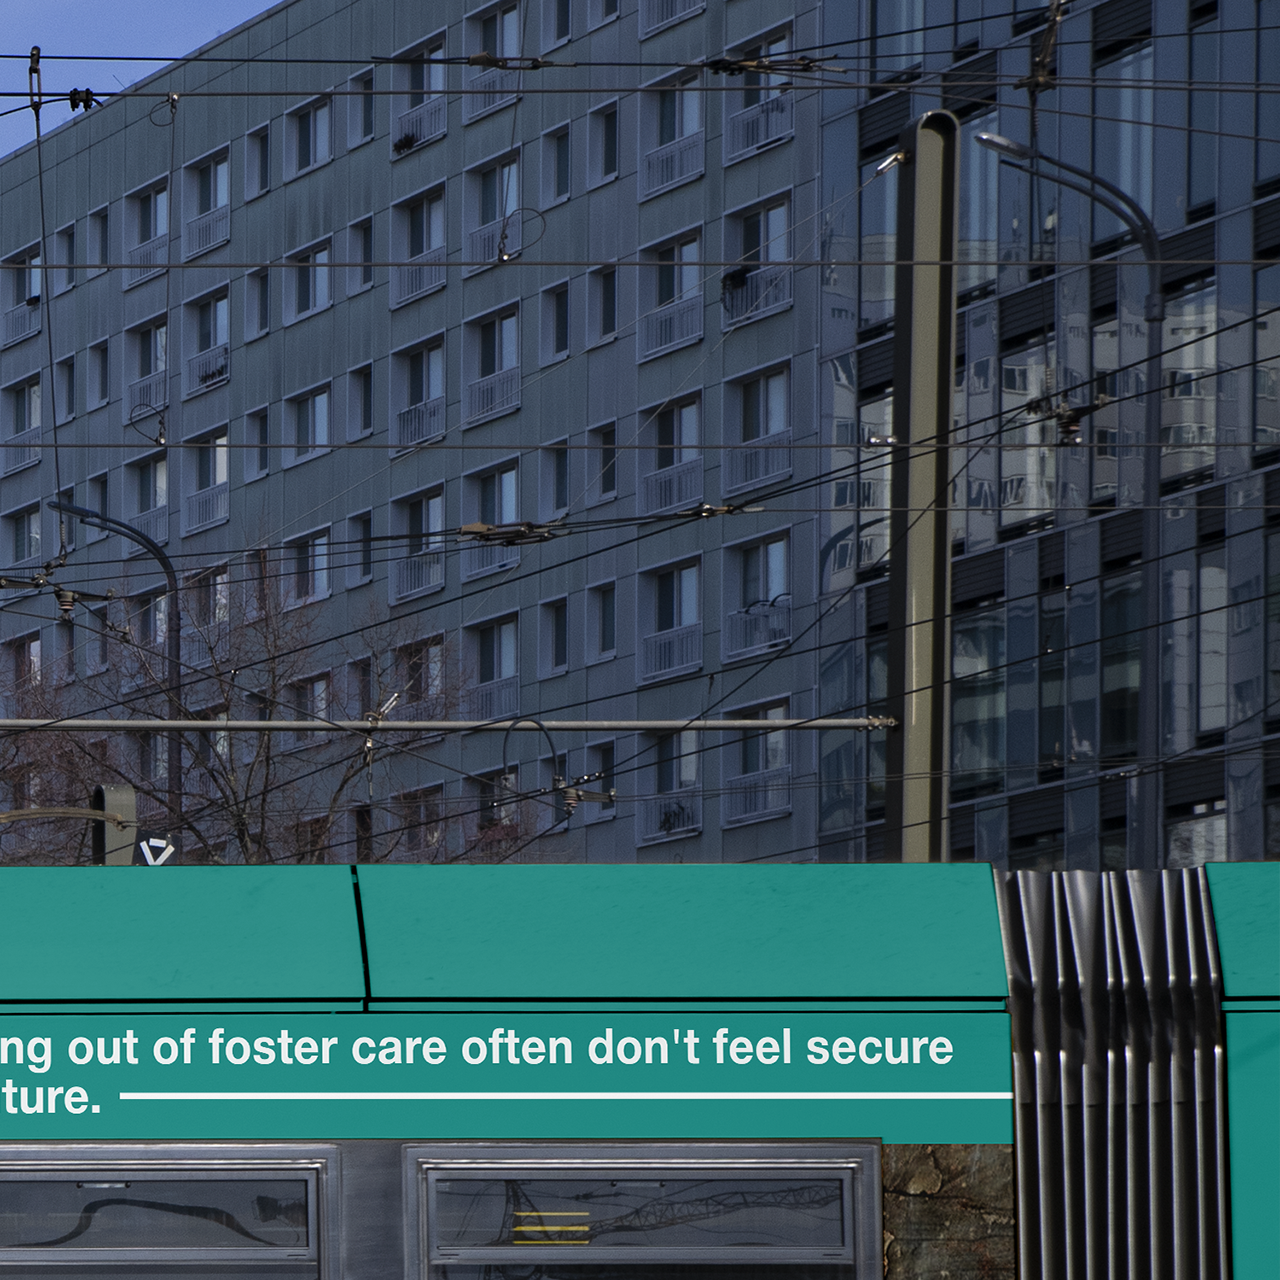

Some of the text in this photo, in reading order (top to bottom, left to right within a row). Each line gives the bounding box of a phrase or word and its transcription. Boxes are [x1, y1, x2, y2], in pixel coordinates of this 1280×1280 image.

[69, 1029, 138, 1065] out
[154, 1027, 195, 1065] of
[209, 1027, 338, 1065] foster
[353, 1036, 446, 1065] care
[462, 1027, 571, 1065] often
[589, 1027, 699, 1065] don't
[713, 1027, 790, 1065] feel
[808, 1036, 953, 1065] secure
